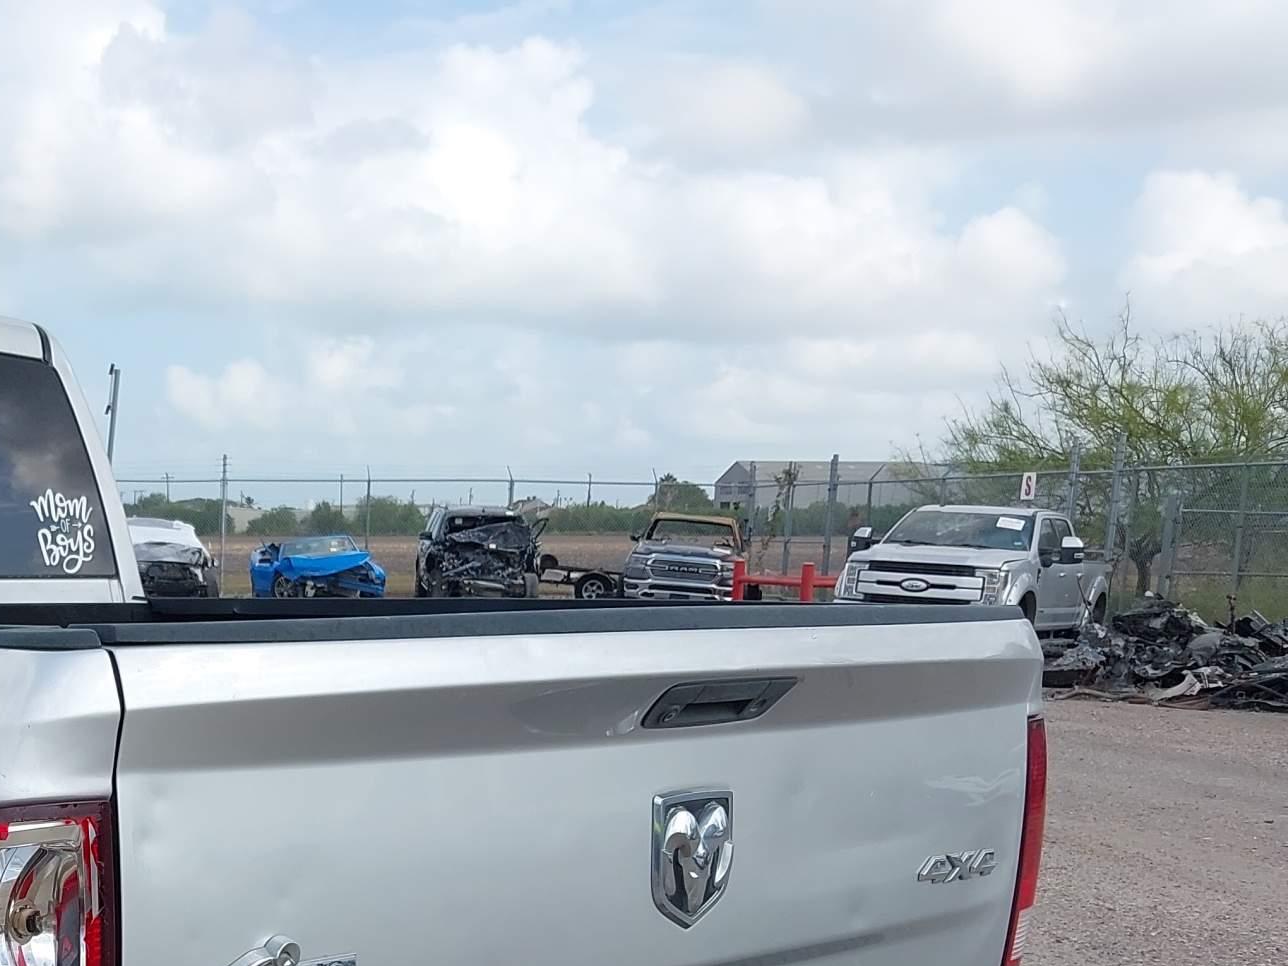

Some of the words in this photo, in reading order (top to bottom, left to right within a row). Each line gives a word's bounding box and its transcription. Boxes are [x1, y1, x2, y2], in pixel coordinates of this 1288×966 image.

[1024, 475, 1032, 497] S
[29, 488, 93, 525] Mom
[59, 518, 71, 533] OF
[37, 524, 95, 574] Boys
